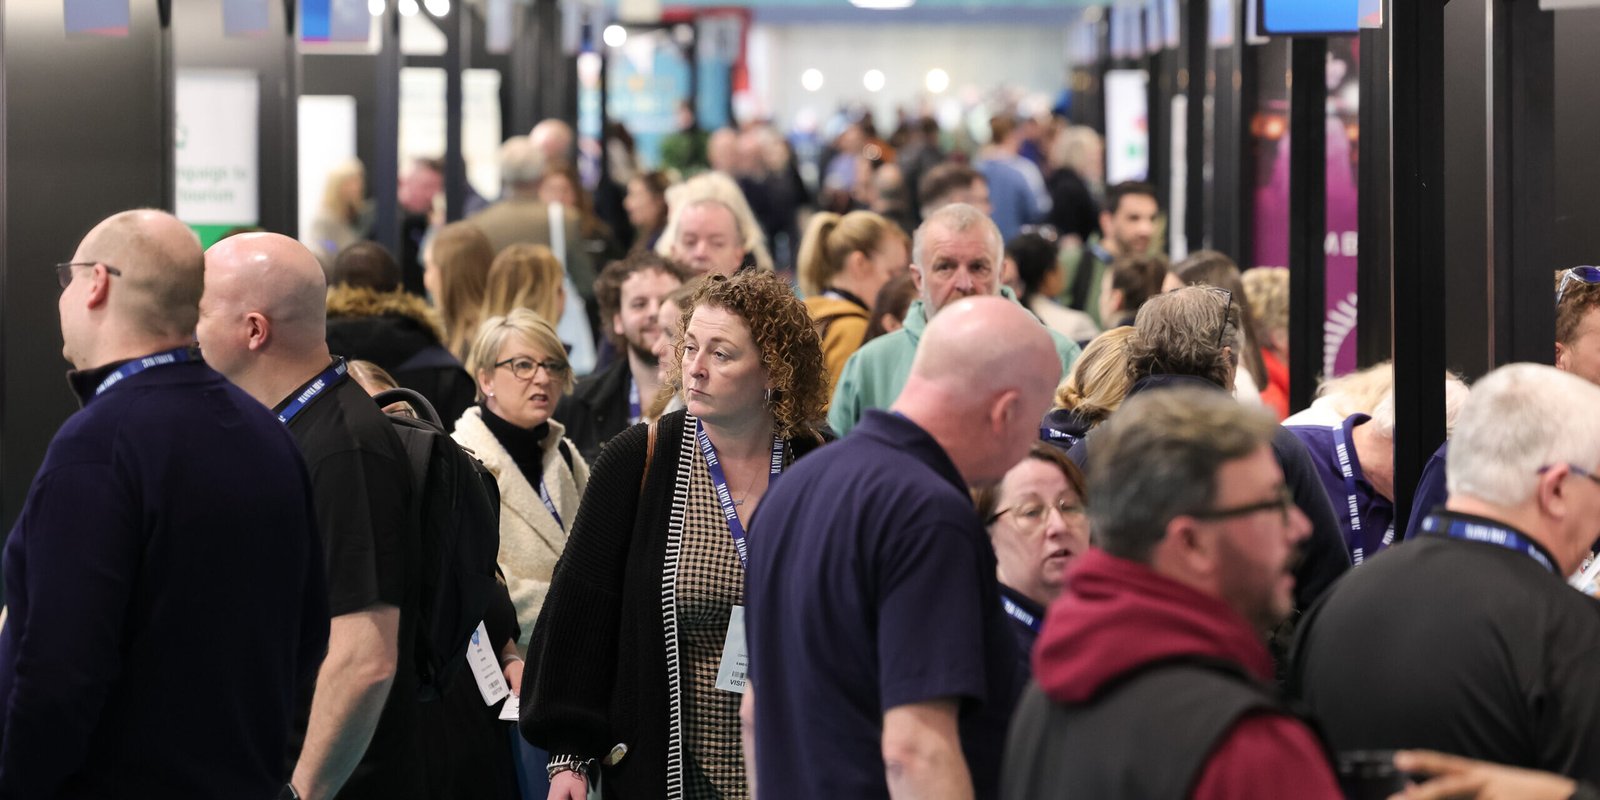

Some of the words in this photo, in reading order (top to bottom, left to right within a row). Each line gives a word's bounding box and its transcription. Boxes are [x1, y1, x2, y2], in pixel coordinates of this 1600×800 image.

[697, 429, 714, 456] MAMMA
[771, 449, 783, 474] MAMMA
[716, 482, 734, 508] MAMMA
[722, 505, 737, 520] MIA!
